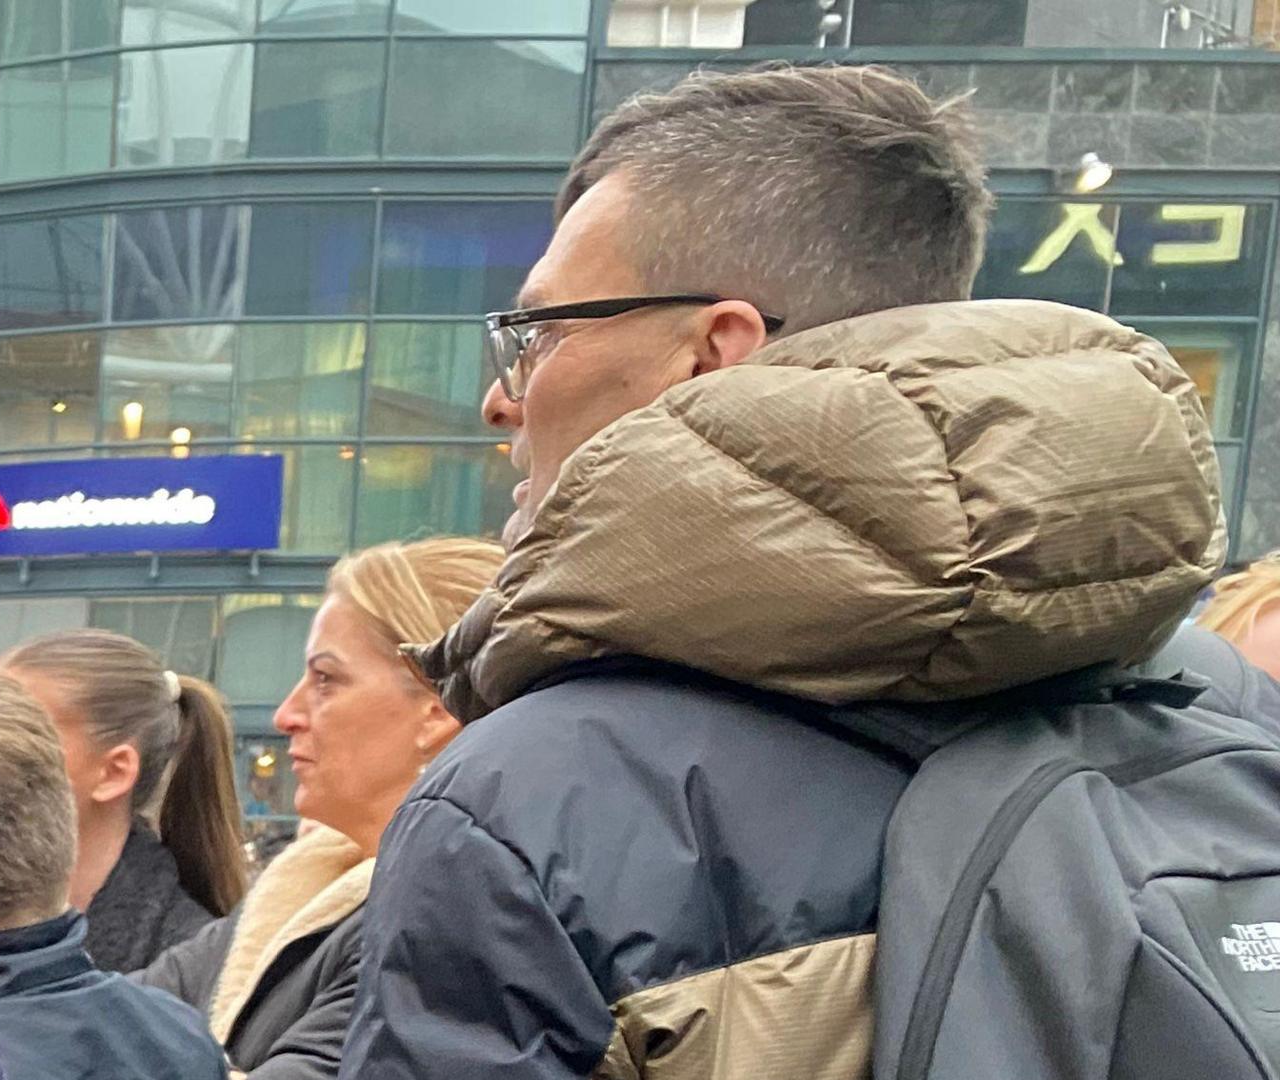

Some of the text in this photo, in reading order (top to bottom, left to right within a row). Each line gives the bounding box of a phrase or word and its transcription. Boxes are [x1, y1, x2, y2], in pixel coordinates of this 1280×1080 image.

[10, 488, 215, 530] nationwide
[1231, 922, 1269, 940] THE
[1221, 937, 1275, 955] NORTH
